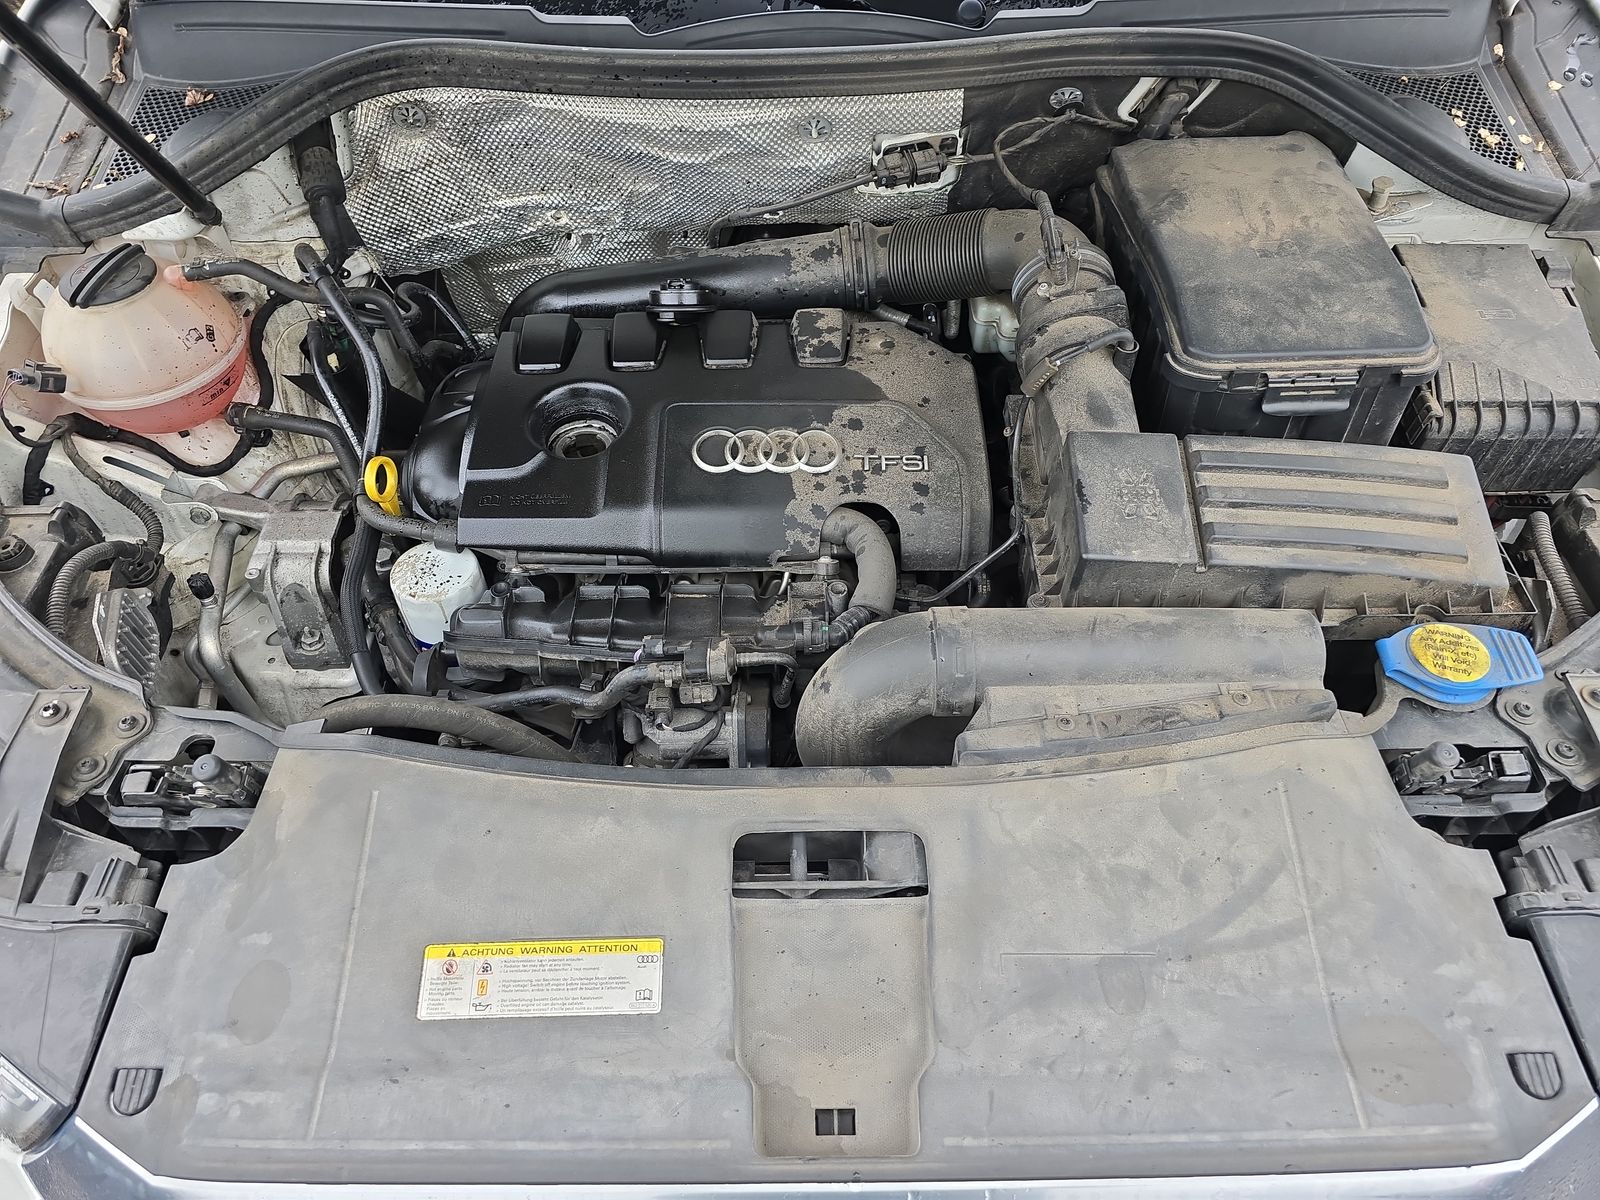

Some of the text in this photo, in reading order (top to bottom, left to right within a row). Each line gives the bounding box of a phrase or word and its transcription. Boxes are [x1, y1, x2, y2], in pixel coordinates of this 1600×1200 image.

[210, 388, 224, 400] min
[854, 454, 930, 472] TFSI
[1425, 628, 1472, 642] WARNING
[1418, 636, 1480, 652] Any Additives
[1432, 652, 1471, 666] Will Void
[1461, 650, 1477, 660] etc)
[1432, 660, 1472, 676] Warranty
[462, 944, 638, 956] ACHTUNG WARNING ATTENTION
